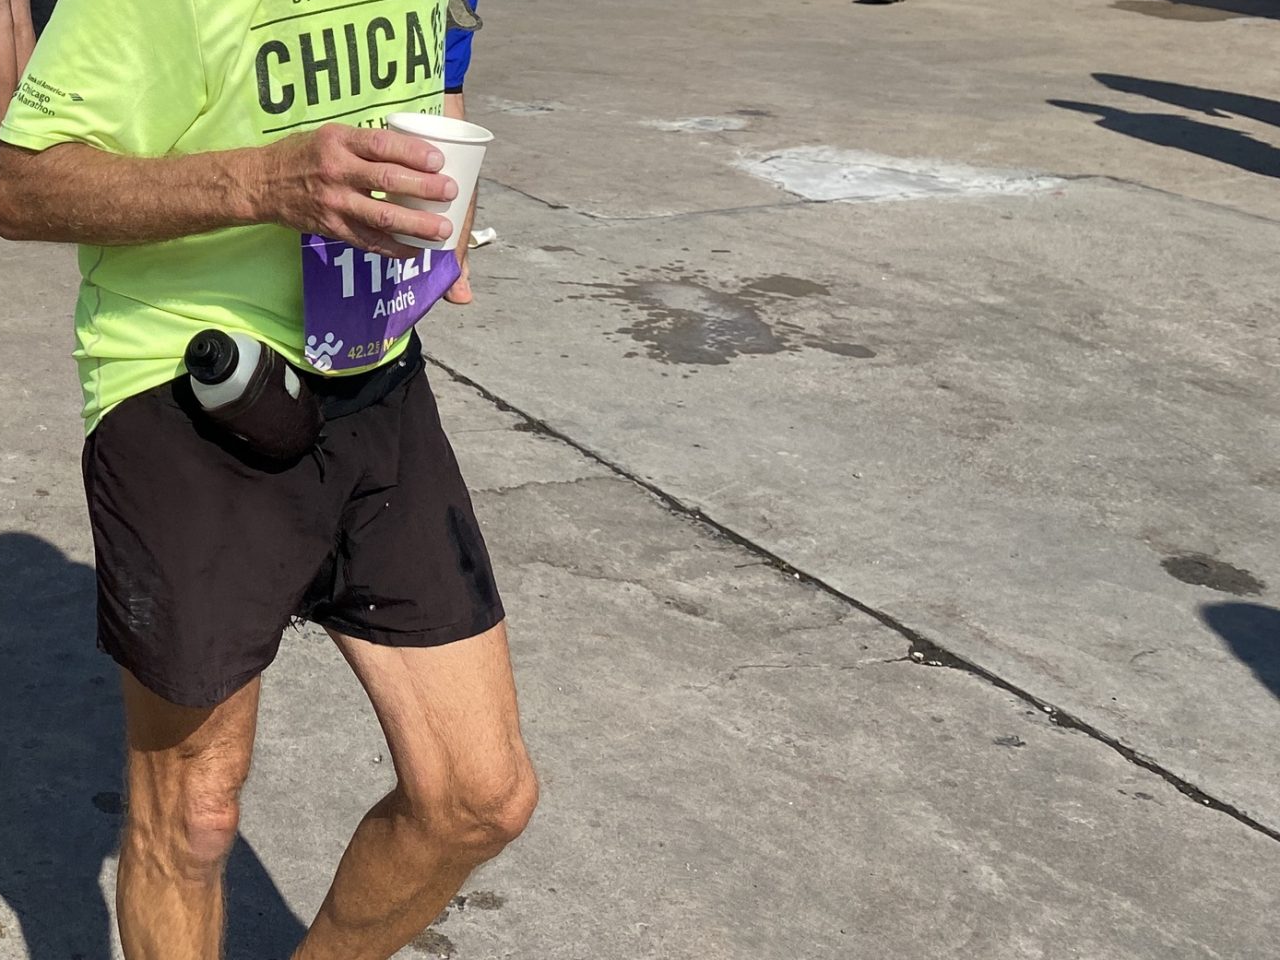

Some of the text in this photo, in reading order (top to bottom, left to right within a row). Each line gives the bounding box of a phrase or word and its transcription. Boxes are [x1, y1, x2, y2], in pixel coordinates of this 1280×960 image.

[22, 82, 51, 103] Chicago
[41, 82, 66, 97] America
[17, 92, 55, 116] Marathon
[372, 286, 416, 319] André
